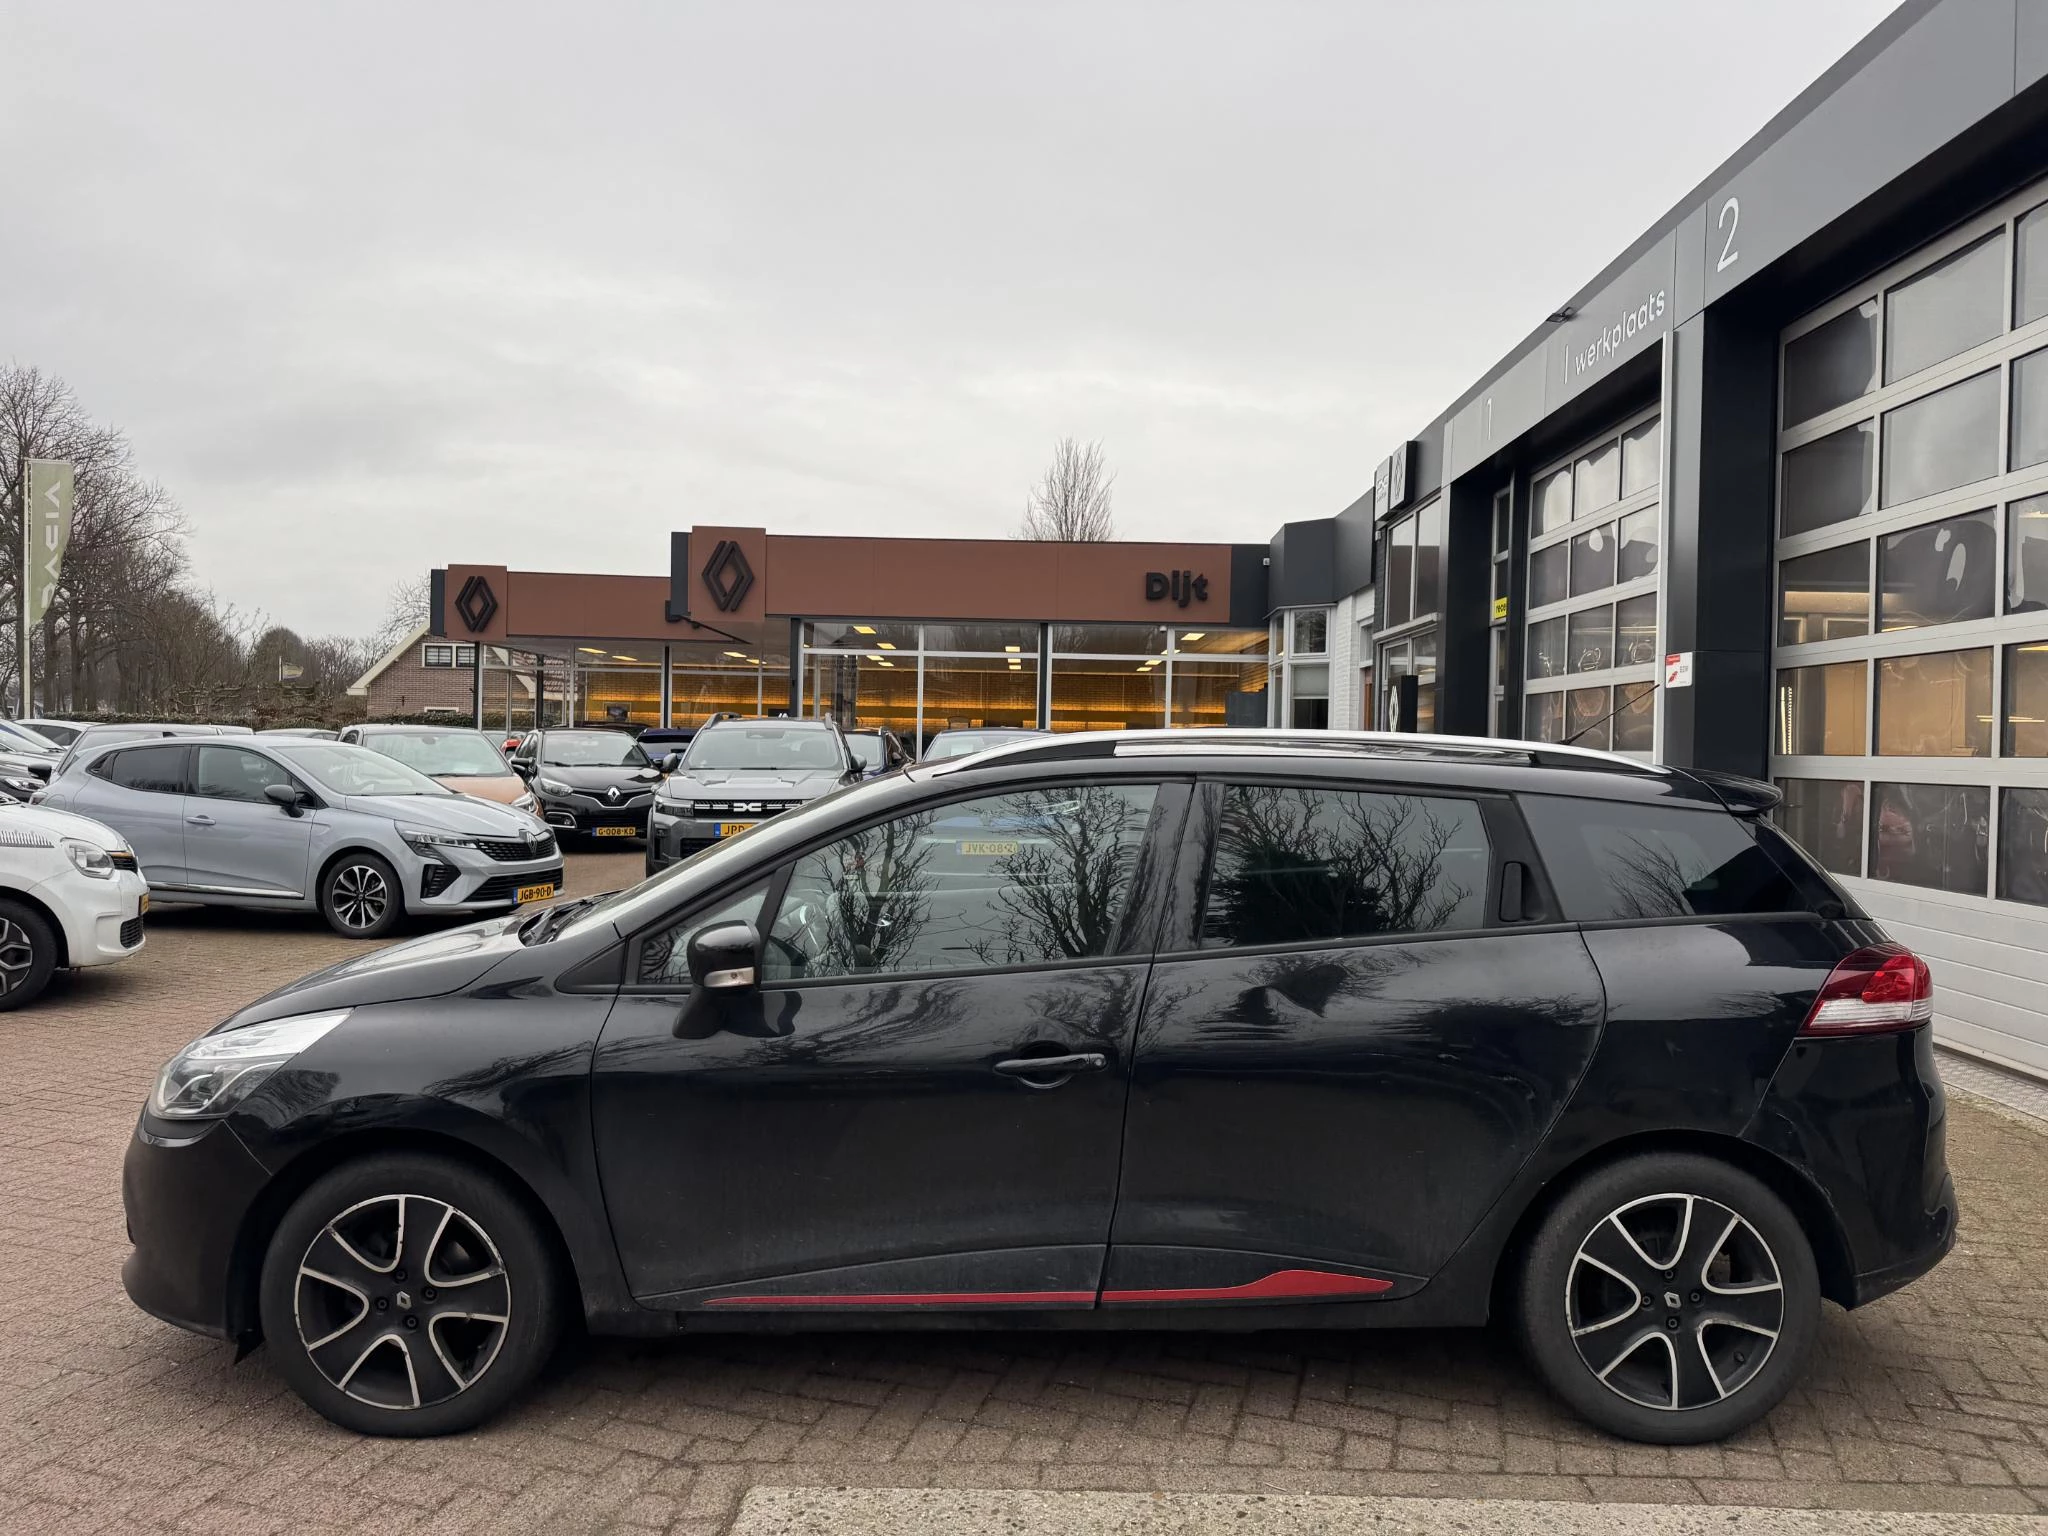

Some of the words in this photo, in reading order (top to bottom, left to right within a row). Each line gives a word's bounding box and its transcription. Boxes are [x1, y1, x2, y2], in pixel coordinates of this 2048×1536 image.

[1717, 197, 1739, 273] 2
[1575, 290, 1665, 376] werkplaats
[519, 886, 552, 901] JGB-90-D
